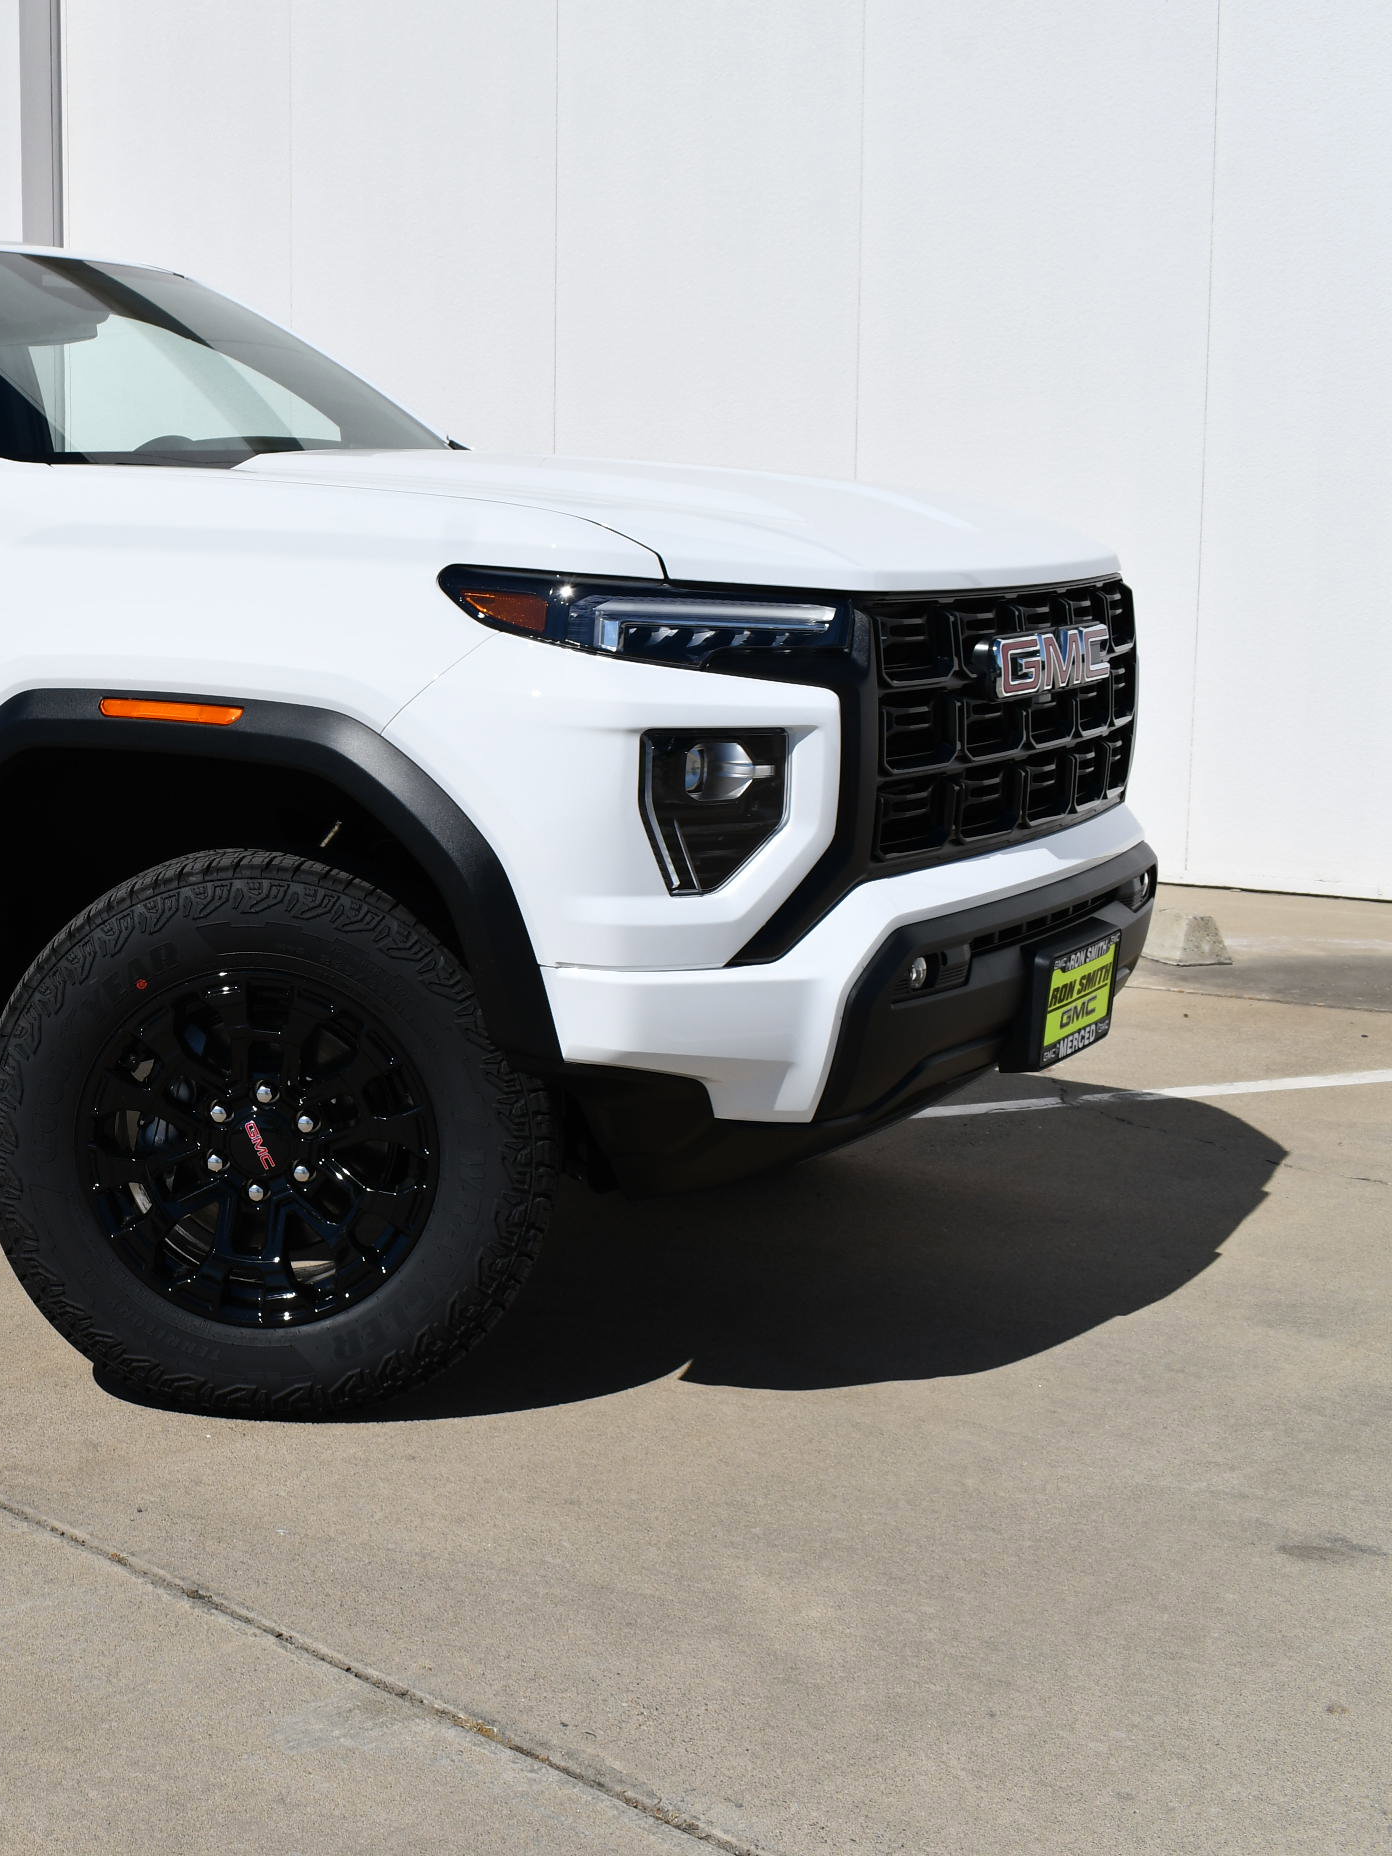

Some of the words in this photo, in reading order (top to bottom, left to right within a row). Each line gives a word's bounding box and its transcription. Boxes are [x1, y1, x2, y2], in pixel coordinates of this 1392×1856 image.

[999, 624, 1110, 697] GMC
[1069, 949, 1086, 970] RON
[1086, 939, 1109, 962] SMITH
[1048, 978, 1077, 1009] RON
[1076, 962, 1112, 995] SMITH
[1060, 995, 1097, 1028] GMC
[1058, 1024, 1096, 1059] MERCED
[244, 1120, 276, 1170] GMC
